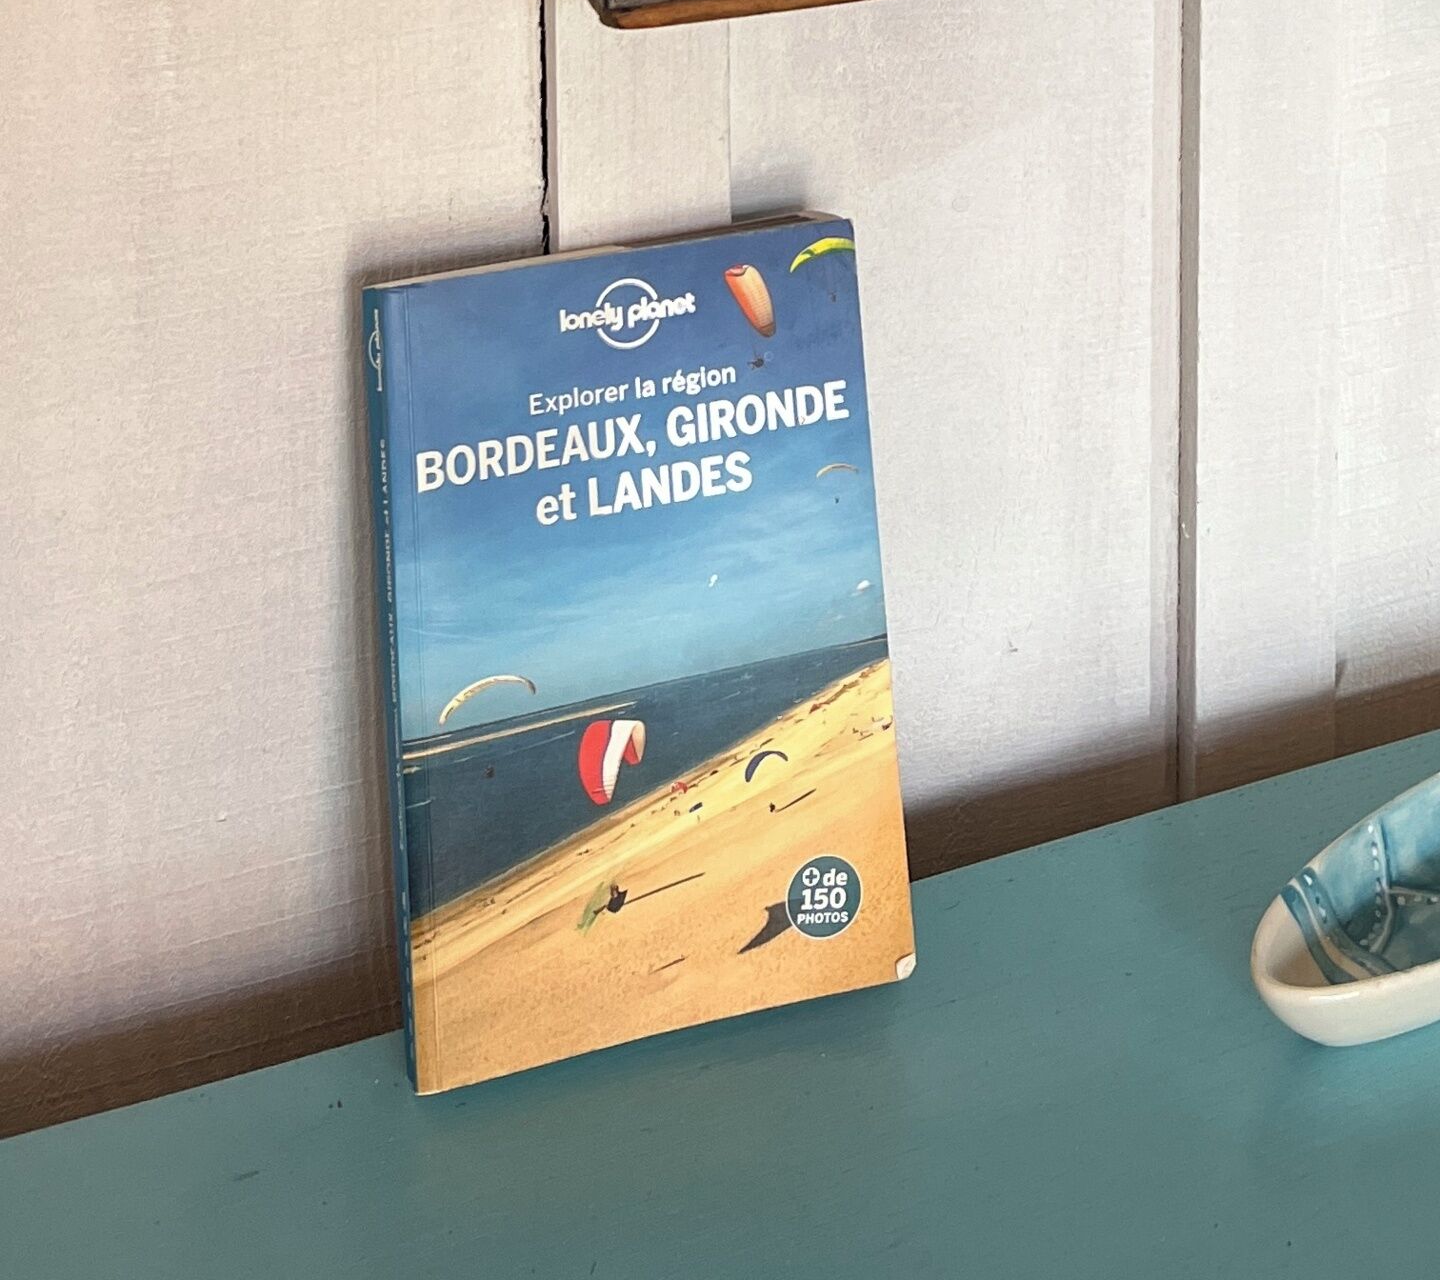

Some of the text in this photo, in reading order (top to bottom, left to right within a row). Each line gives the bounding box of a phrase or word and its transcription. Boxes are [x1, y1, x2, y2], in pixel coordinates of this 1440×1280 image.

[560, 291, 697, 333] lonely planet
[528, 363, 737, 417] Explorer la région
[415, 379, 850, 493] BORDEAUX, GIRONDE
[536, 451, 753, 526] et LANDES
[822, 868, 848, 887] de
[796, 911, 849, 926] PHOTOS
[801, 887, 847, 911] 150
